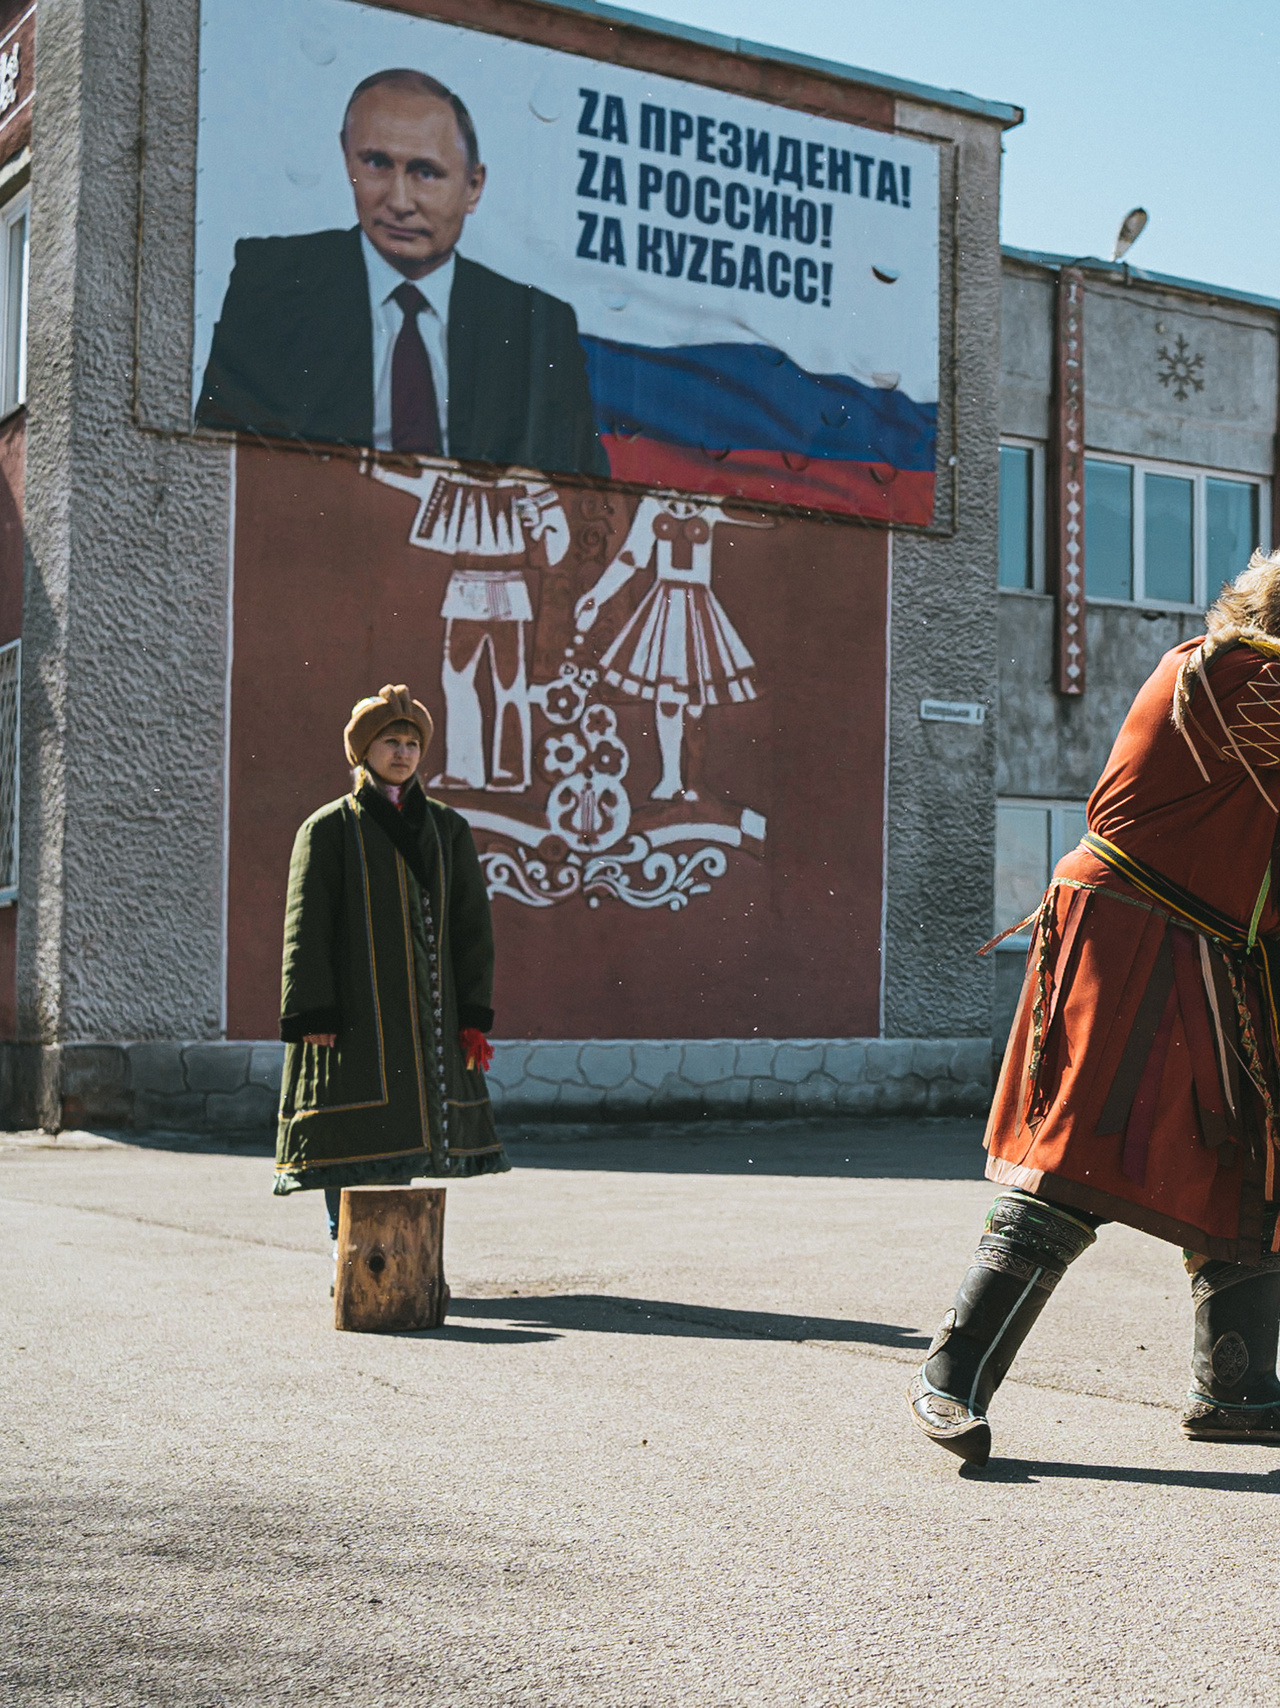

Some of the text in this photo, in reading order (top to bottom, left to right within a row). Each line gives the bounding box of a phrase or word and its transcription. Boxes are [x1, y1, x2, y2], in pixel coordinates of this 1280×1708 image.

[639, 102, 911, 209] ПРЕЗИДЕНТА!
[638, 162, 833, 249] РОССИЮ!
[637, 223, 833, 308] КУZБАСС!
